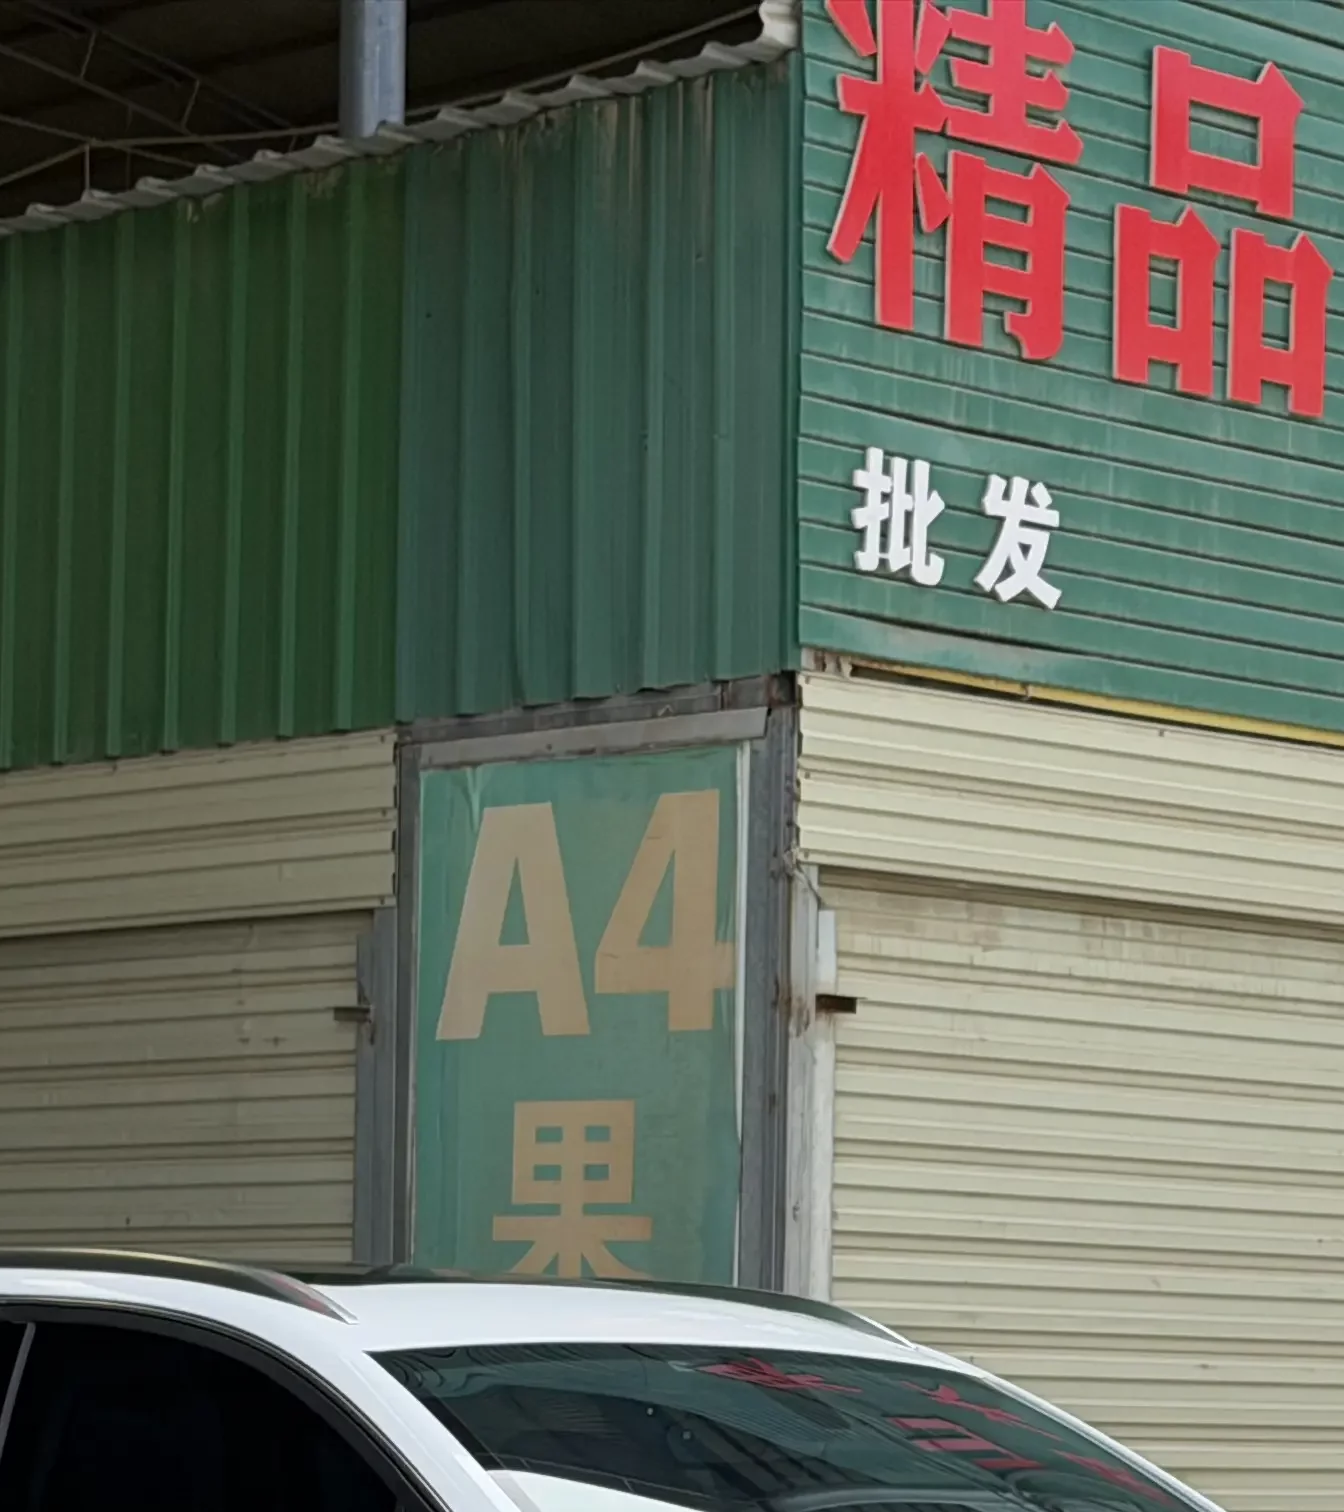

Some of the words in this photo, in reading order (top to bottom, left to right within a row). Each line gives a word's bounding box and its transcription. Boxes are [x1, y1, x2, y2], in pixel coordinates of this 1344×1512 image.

[852, 446, 1061, 609] 批发
[436, 788, 736, 1041] A4
[492, 1100, 656, 1280] 果
